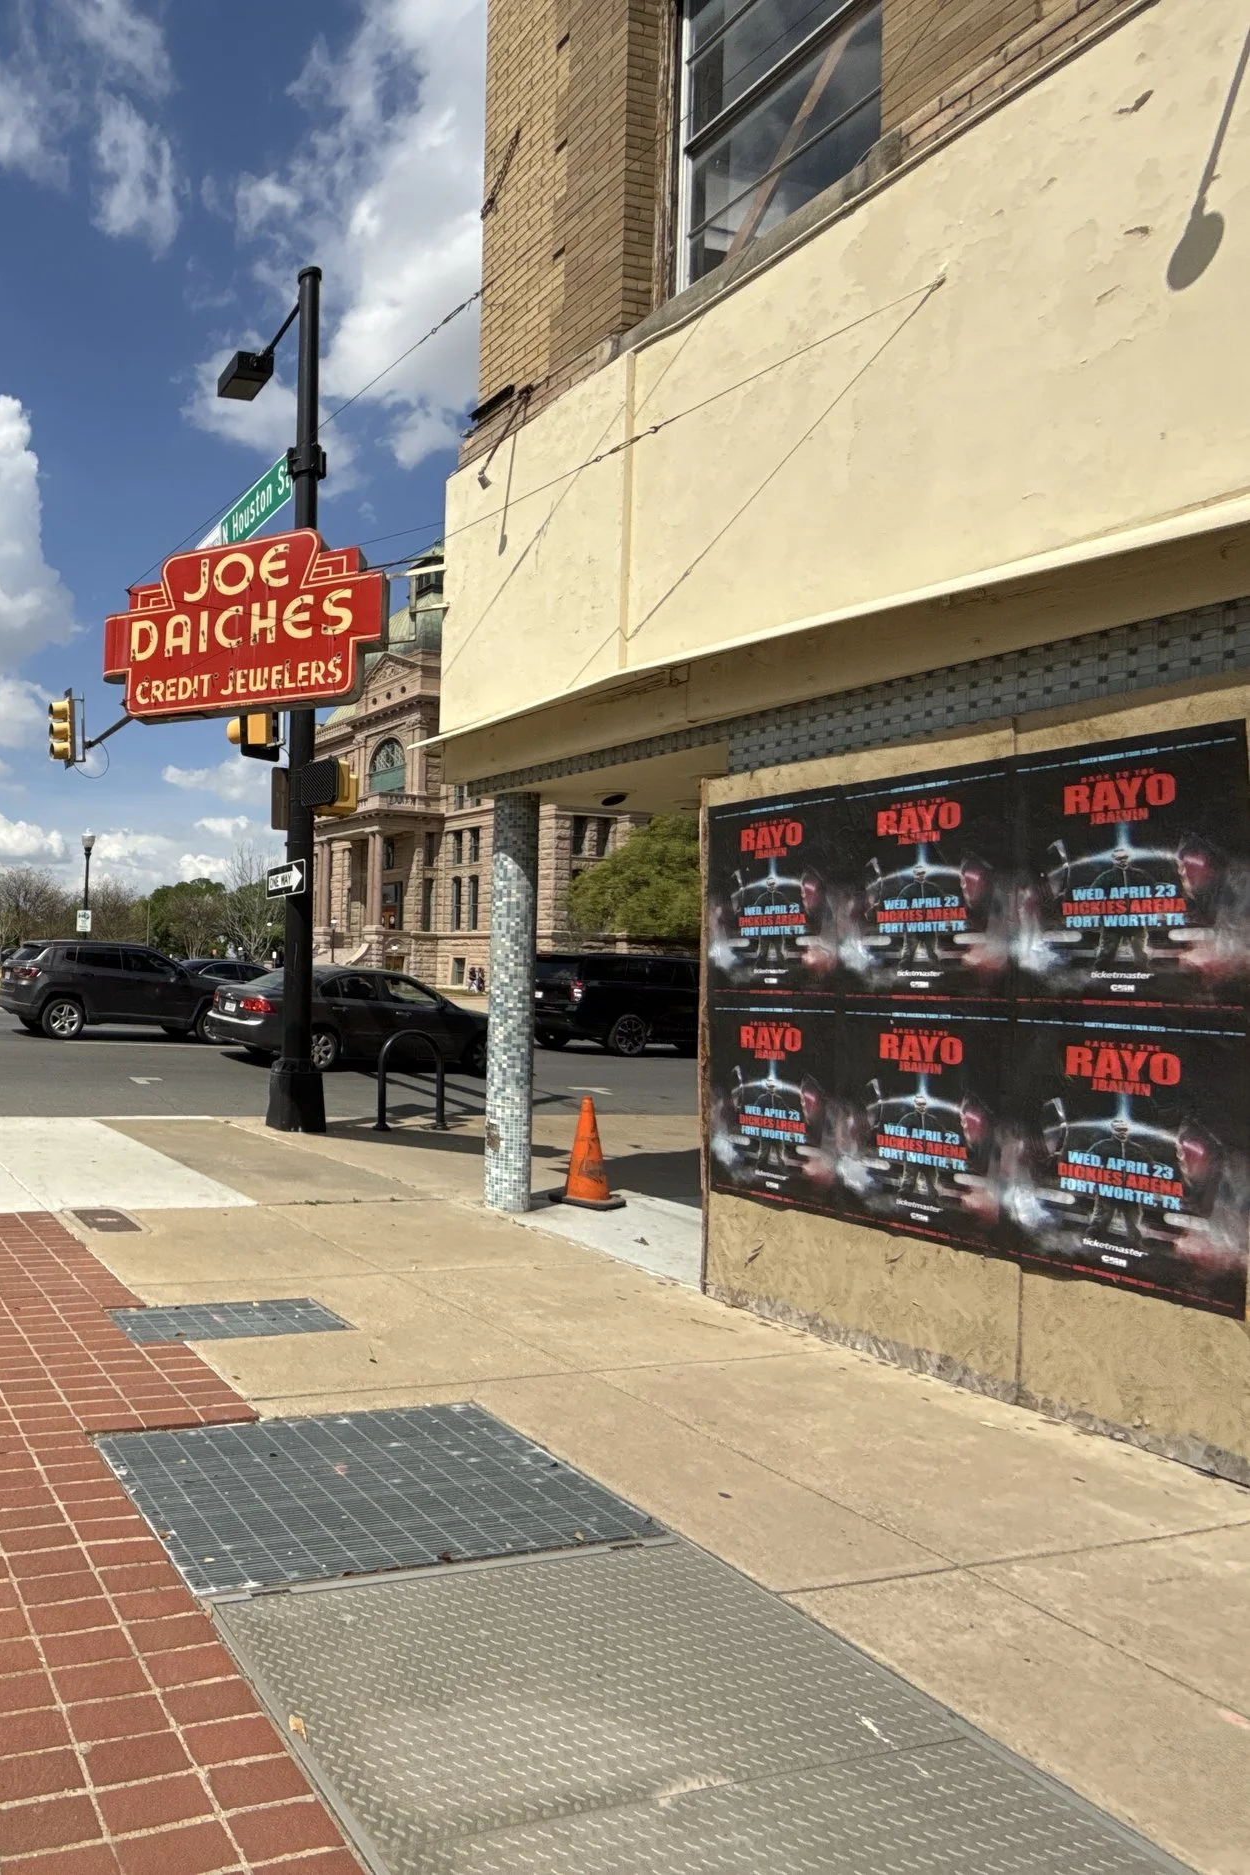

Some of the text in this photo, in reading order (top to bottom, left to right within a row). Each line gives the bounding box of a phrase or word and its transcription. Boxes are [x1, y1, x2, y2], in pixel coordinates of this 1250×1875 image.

[222, 462, 291, 546] N Houston St
[183, 543, 290, 602] JOE
[130, 588, 353, 662] DAICHES
[135, 655, 343, 705] CREDIT JEWELERS
[1063, 773, 1177, 815] RAYO
[877, 802, 961, 837] RAYO
[740, 822, 803, 852] RAYO
[270, 873, 291, 889] ONE WAY
[1072, 884, 1176, 901] WED. APRIL 23
[744, 904, 800, 916] WED. APRIL 23
[876, 907, 967, 923] DICKIES ARENA
[884, 896, 959, 910] WED. APRIL 23
[1062, 898, 1187, 915] DICKIES ARENA
[738, 913, 806, 927] DICKIES ARENA
[879, 920, 966, 933] FORT WORTH, TX
[1066, 913, 1185, 928] FORT WORTH, TX
[1090, 971, 1151, 980] ticketmaster
[740, 1025, 802, 1052] RAYO
[879, 1033, 963, 1065] RAYO
[1065, 1046, 1181, 1086] RAYO
[876, 1134, 967, 1159] DICKIES ARENA
[883, 1124, 960, 1145] WED. APRIL 23
[878, 1147, 966, 1171] FORT WORTH, TX
[1067, 1151, 1174, 1180] WED. APRIL 23
[1057, 1162, 1183, 1197] DICKIES ARENA
[896, 1198, 940, 1213] ticketmaster
[1060, 1177, 1181, 1211] FORT WORTH, TX
[1082, 1238, 1144, 1258] ticketmaster
